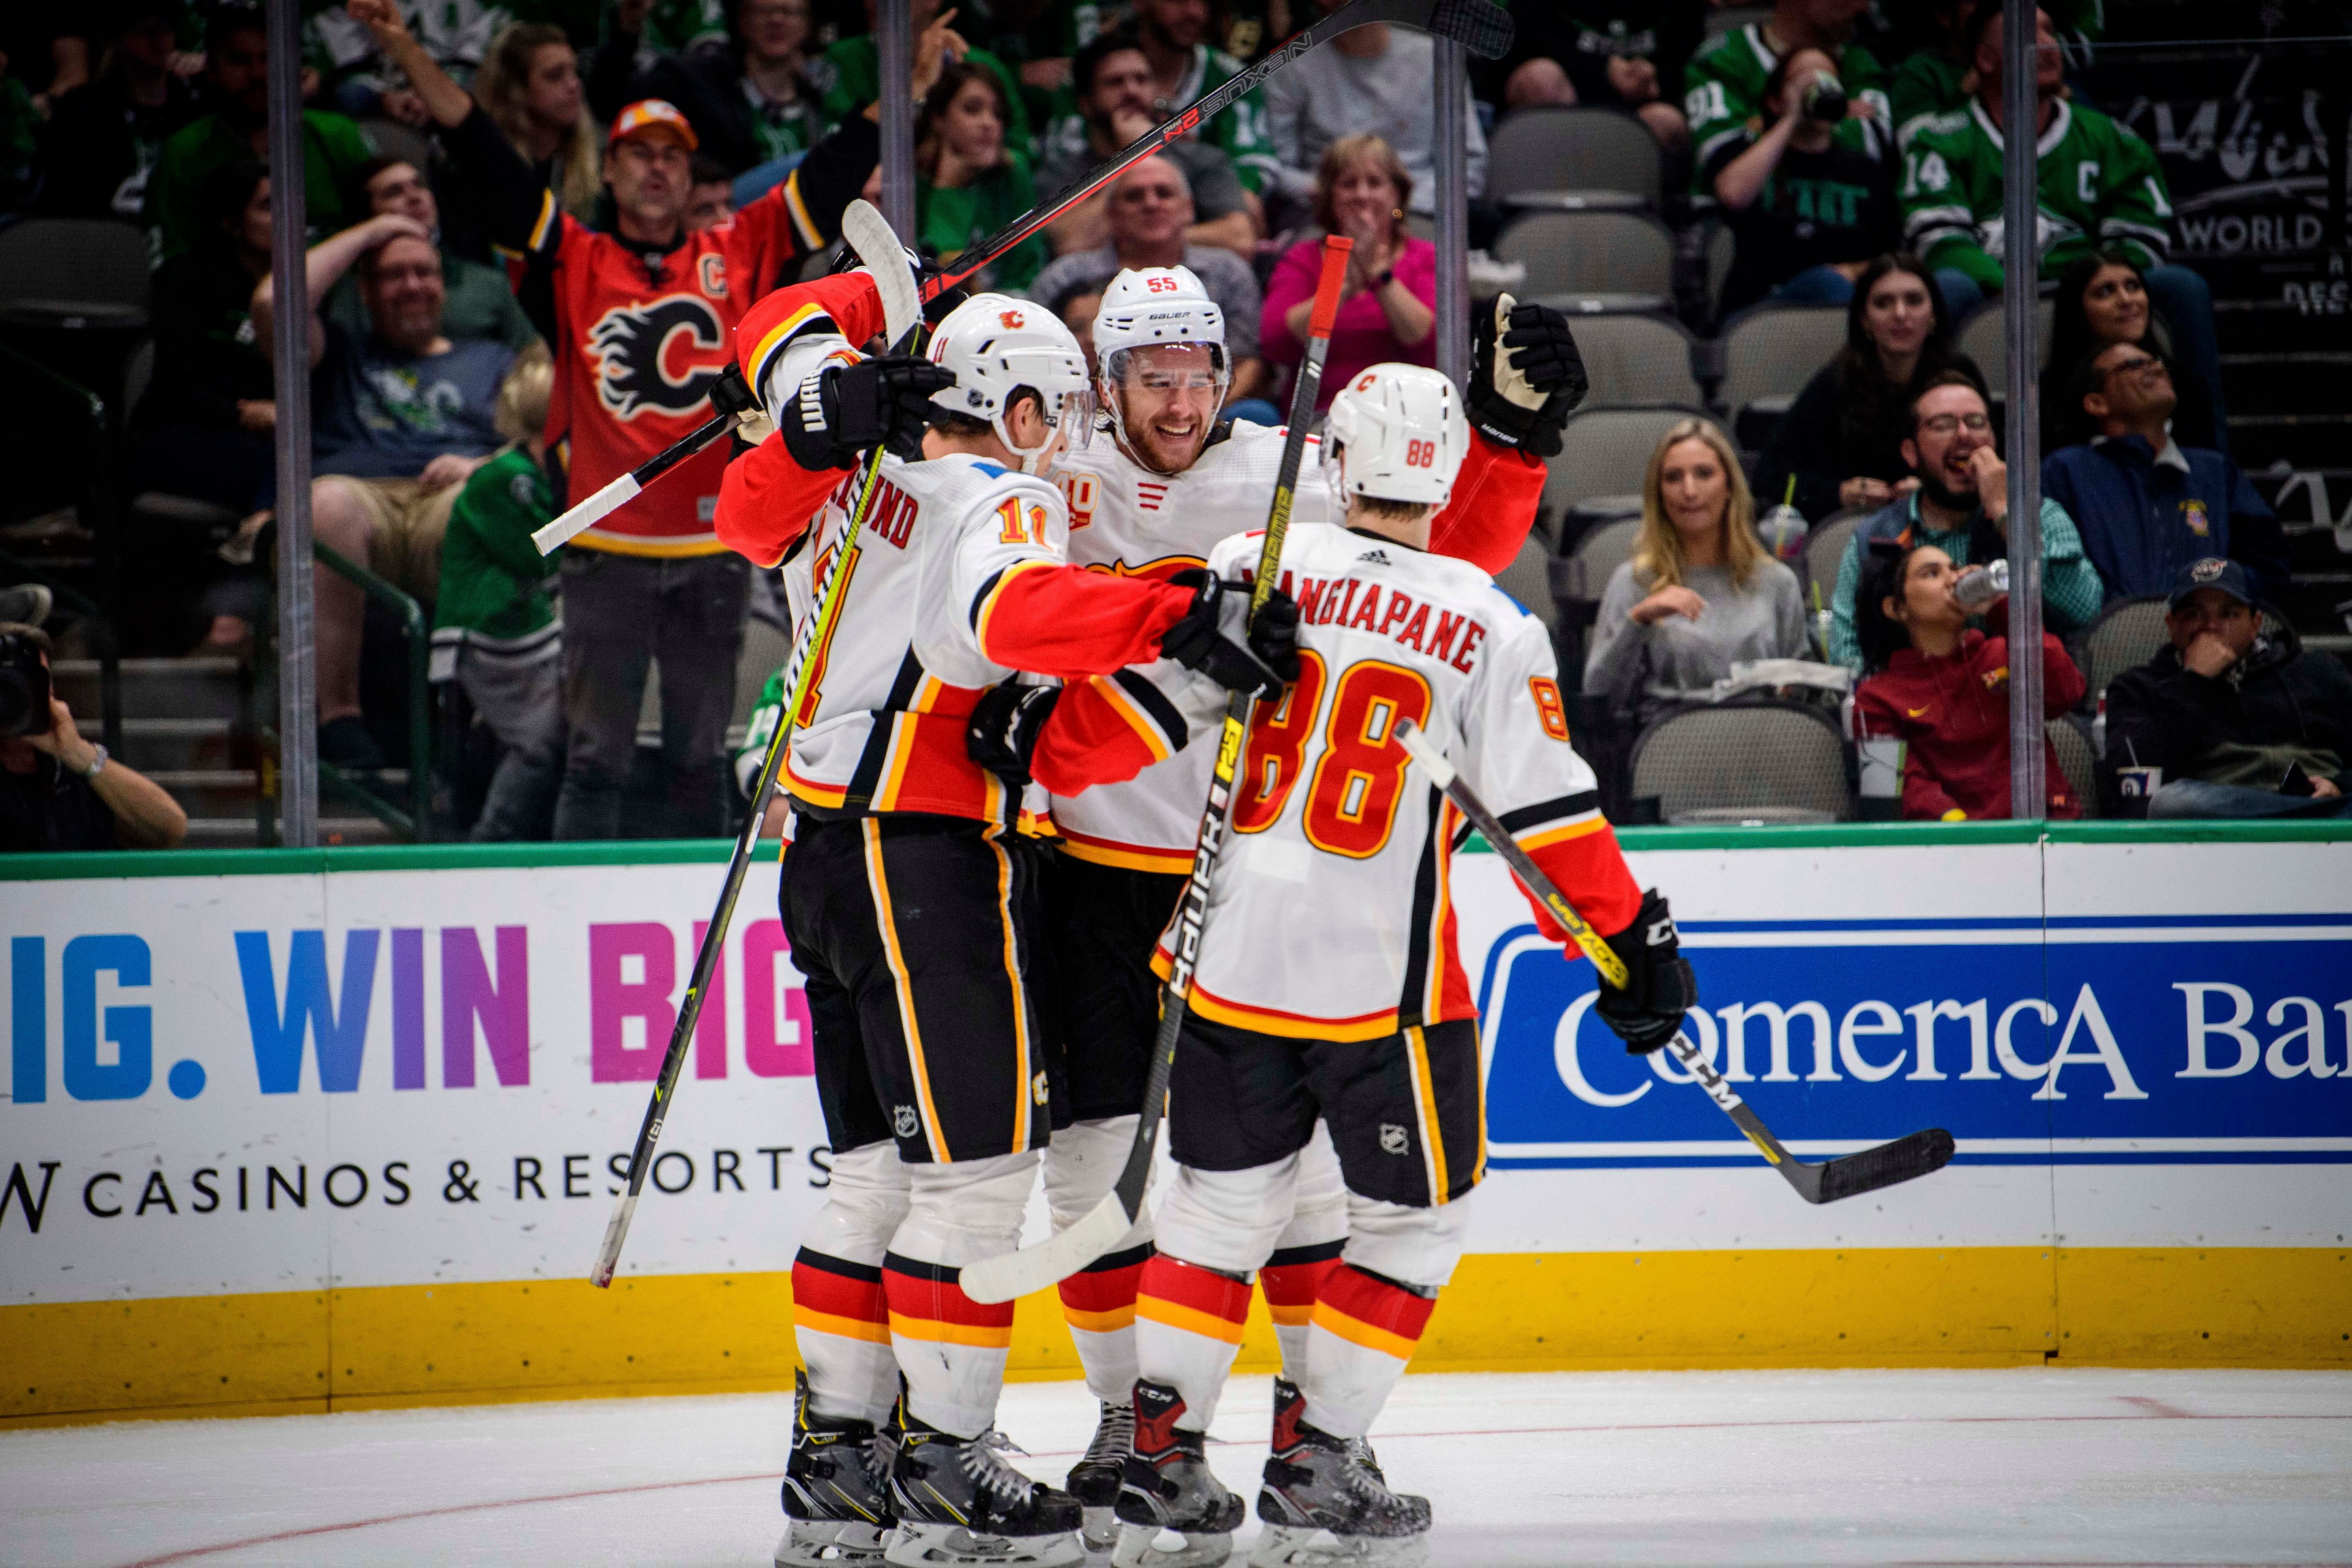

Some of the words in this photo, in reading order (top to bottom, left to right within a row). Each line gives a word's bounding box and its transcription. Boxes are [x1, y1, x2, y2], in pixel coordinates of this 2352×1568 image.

[1203, 31, 1313, 119] NEXUS
[1903, 150, 1951, 198] 14
[2077, 160, 2101, 202] C
[2178, 213, 2323, 252] WORLD
[697, 253, 729, 298] C
[1146, 277, 1178, 293] 55
[1149, 312, 1190, 320] BAUER
[1406, 439, 1435, 467] 88
[1233, 648, 1432, 860] 88
[1169, 811, 1225, 999] BAUER
[233, 925, 531, 1095] WIN
[588, 918, 817, 1084] BIG
[1666, 1028, 1742, 1112] CCM
[82, 1161, 411, 1218] CASINOS
[442, 1159, 481, 1204] &
[513, 1146, 831, 1200] RESORTS
